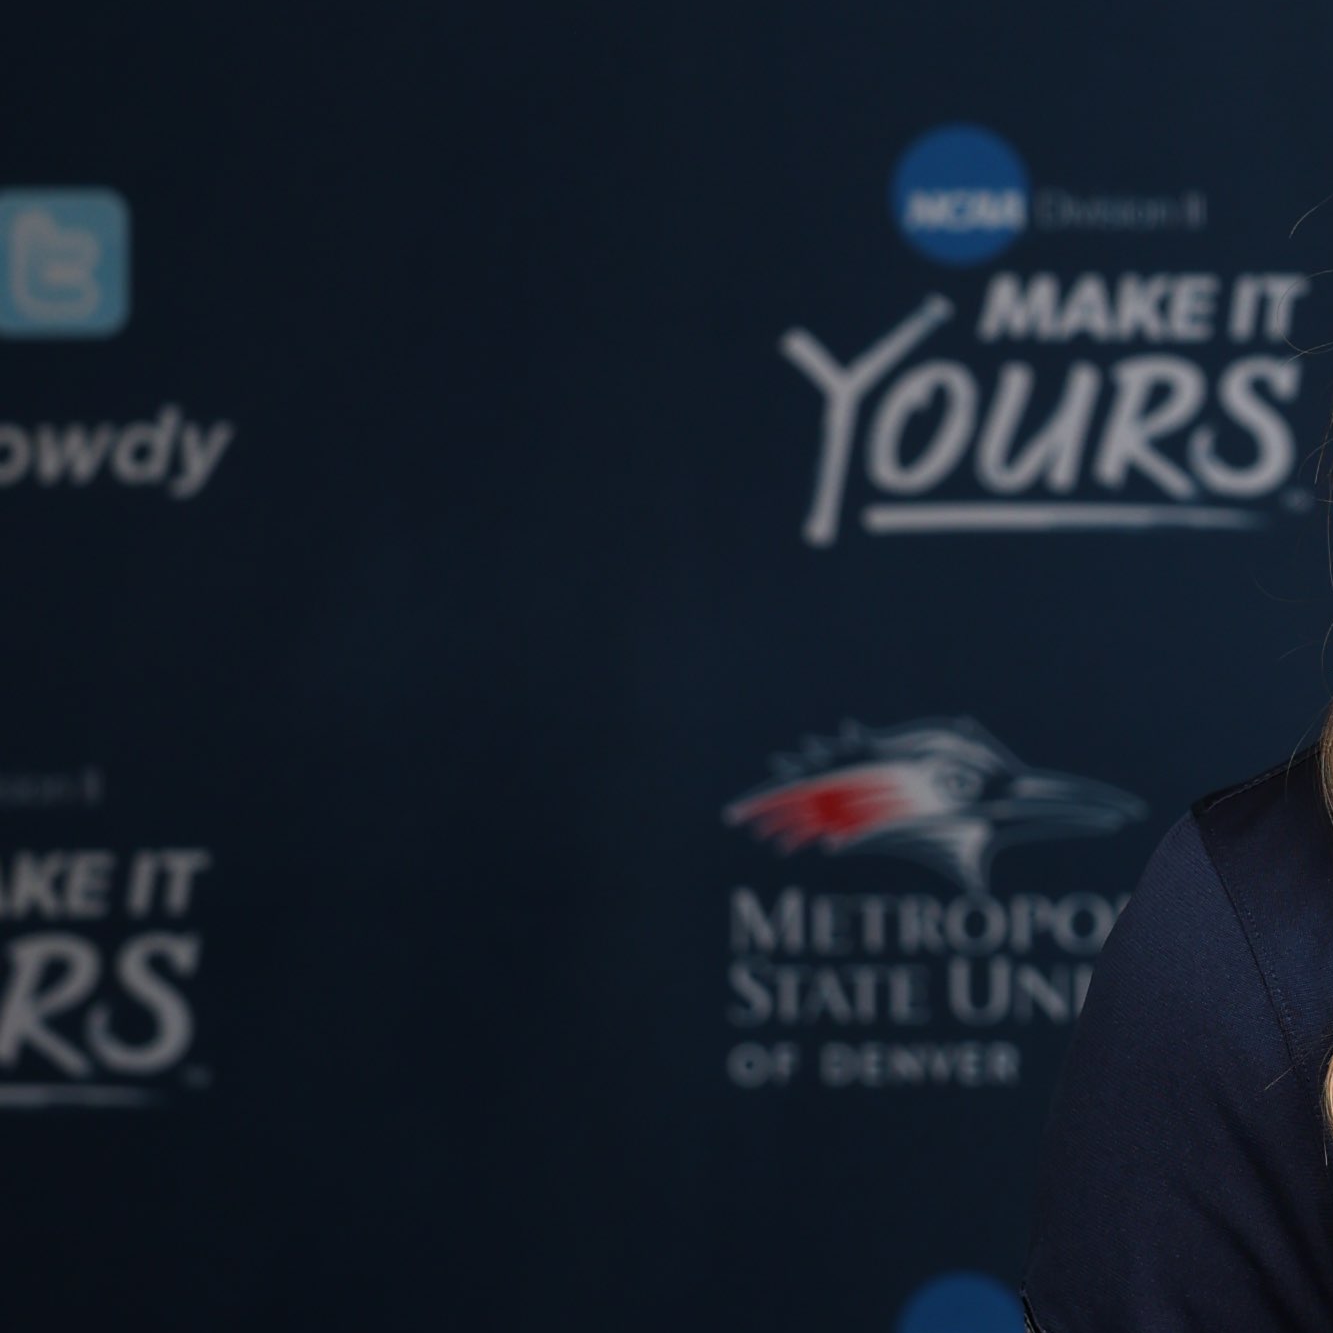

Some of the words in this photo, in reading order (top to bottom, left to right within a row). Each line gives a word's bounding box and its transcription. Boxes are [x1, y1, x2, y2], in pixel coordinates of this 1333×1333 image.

[975, 270, 1221, 343] MAKE
[1228, 271, 1310, 342] IT
[776, 291, 1303, 549] YOURS
[125, 846, 213, 920] IT
[726, 960, 930, 1028] STATE
[725, 1041, 798, 1090] OF
[818, 1041, 1021, 1088] DENVER
